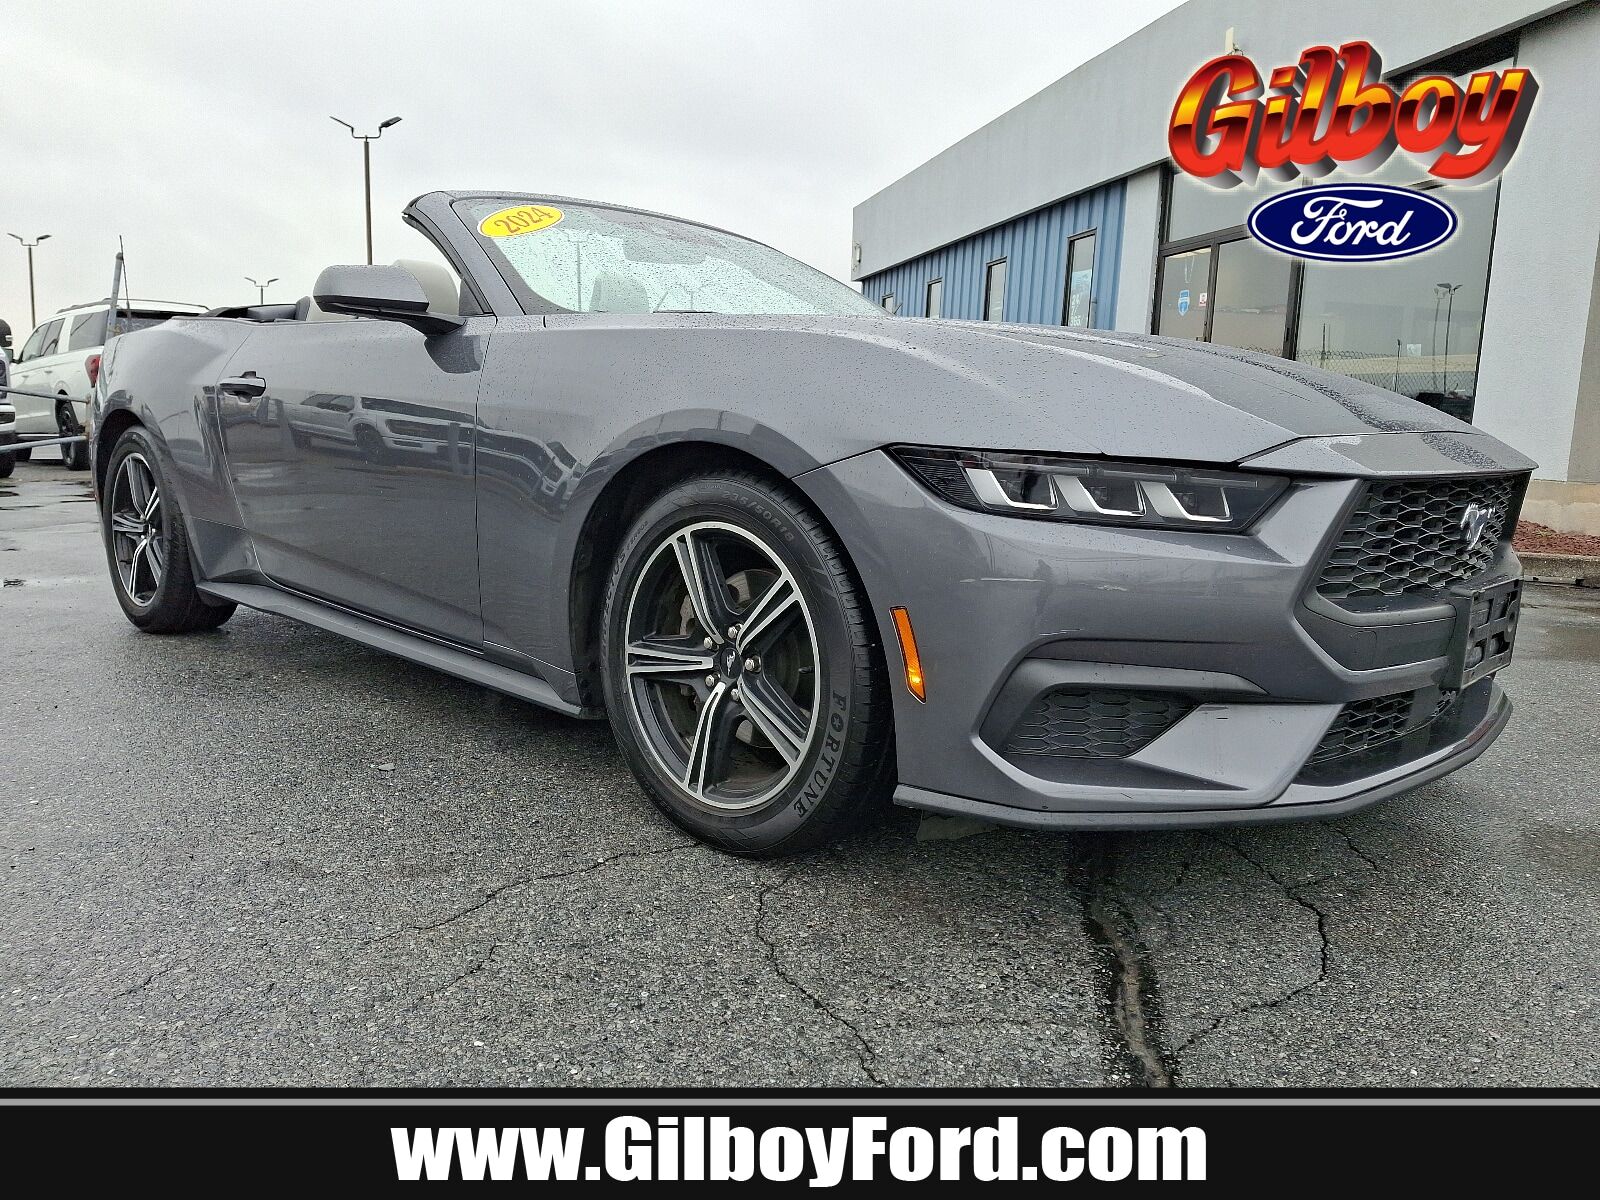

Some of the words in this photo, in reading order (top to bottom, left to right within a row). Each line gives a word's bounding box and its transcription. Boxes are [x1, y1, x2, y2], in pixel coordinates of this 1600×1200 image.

[494, 207, 553, 233] 2024
[721, 490, 794, 541] 235/50R18
[793, 690, 847, 818] FORTUNE
